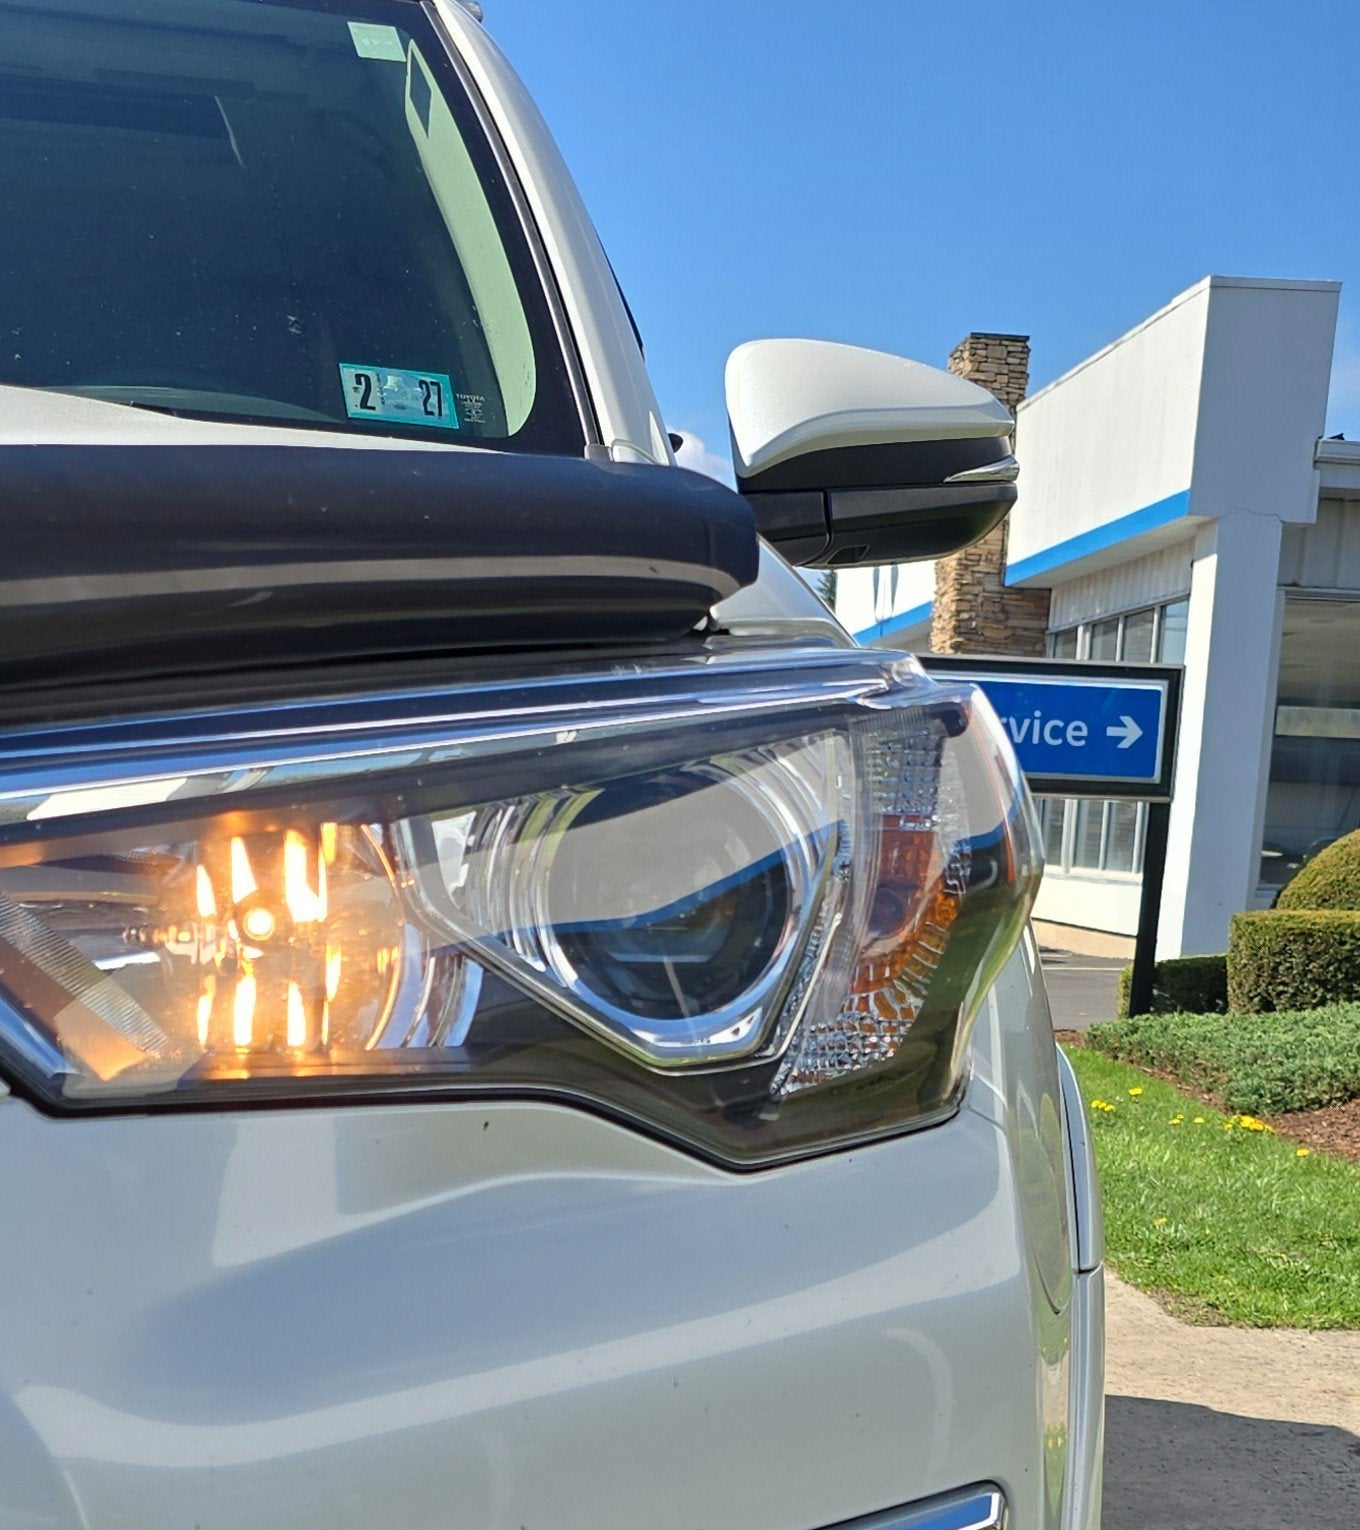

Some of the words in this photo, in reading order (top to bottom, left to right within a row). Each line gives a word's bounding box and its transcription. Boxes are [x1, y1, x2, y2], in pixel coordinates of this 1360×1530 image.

[355, 373, 376, 410] 2
[419, 380, 443, 417] 27
[1001, 710, 1088, 747] vice
